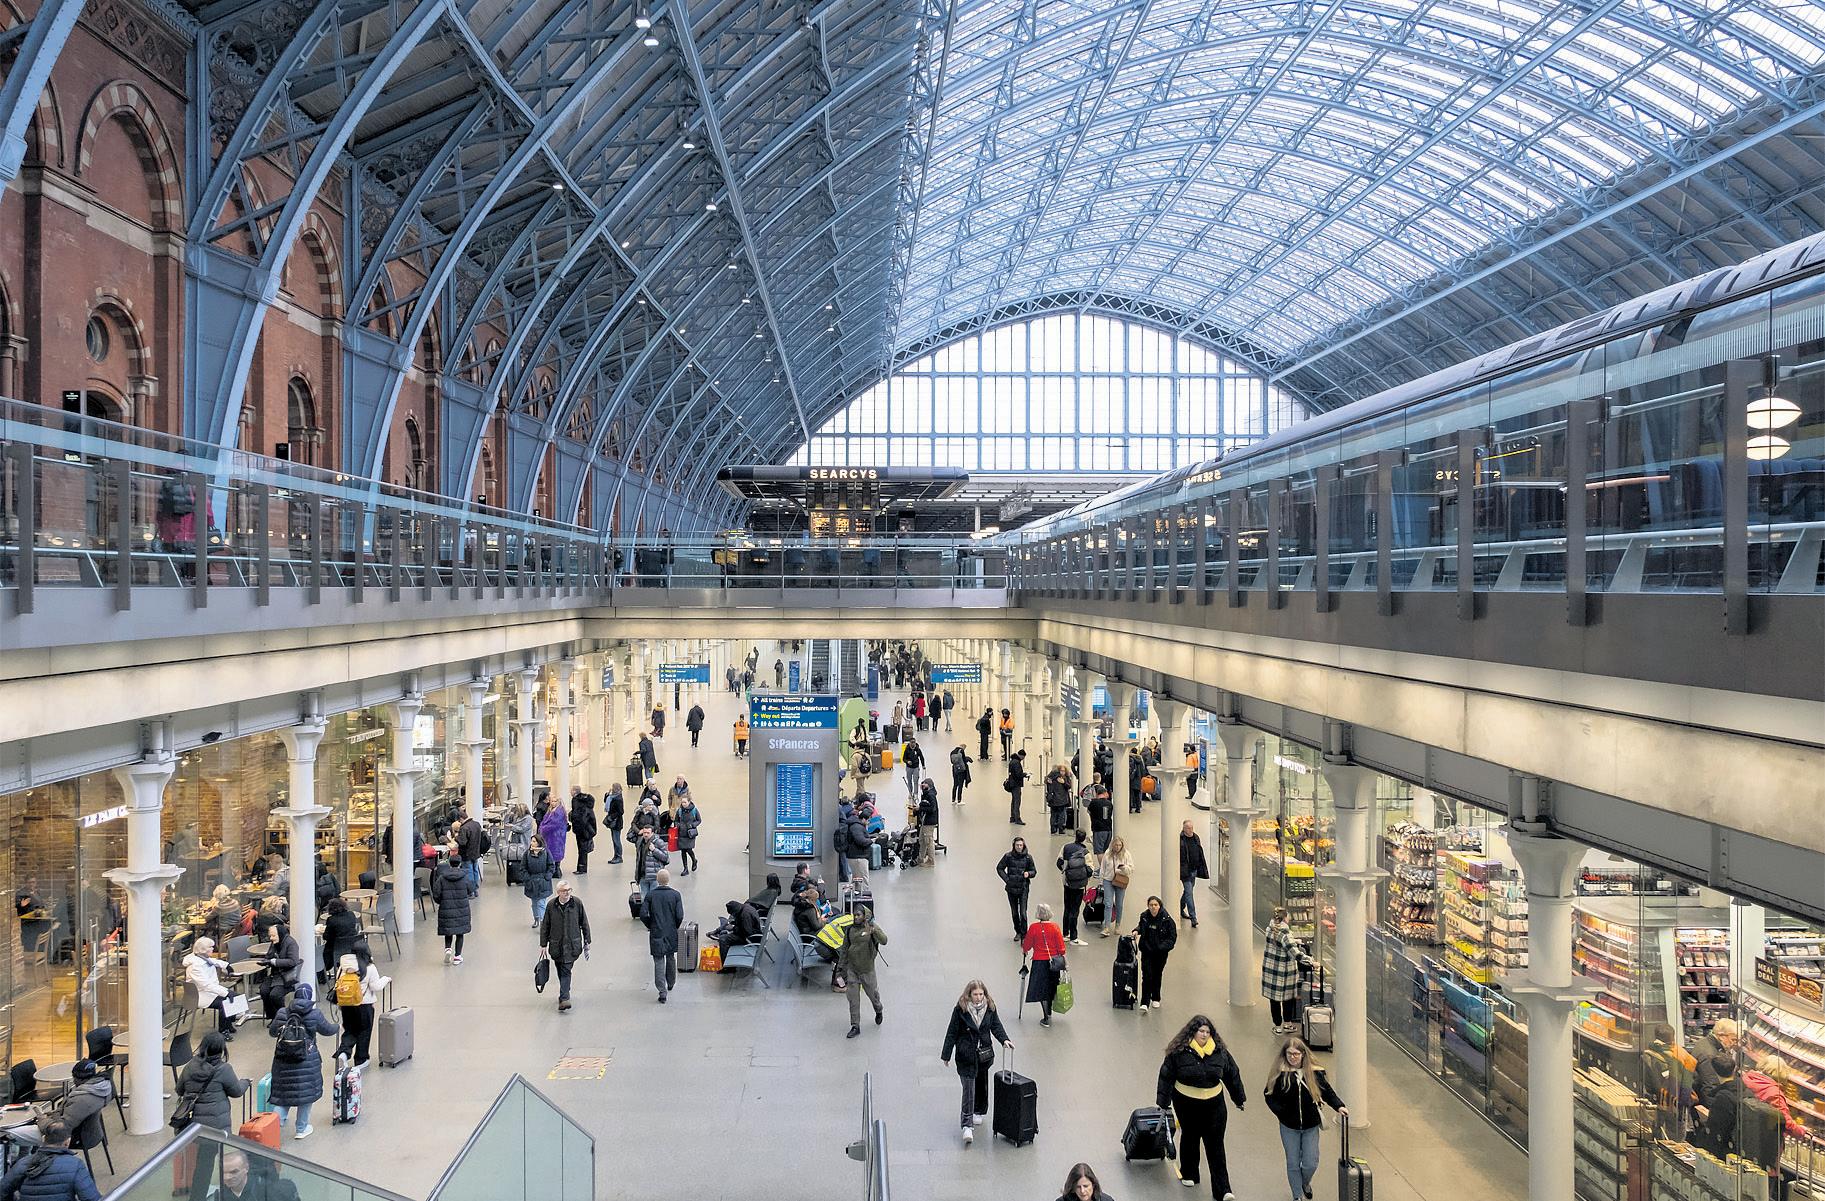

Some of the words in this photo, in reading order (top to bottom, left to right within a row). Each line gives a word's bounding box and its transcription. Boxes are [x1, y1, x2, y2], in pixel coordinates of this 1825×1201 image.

[810, 469, 877, 479] SEARCYS
[1757, 963, 1775, 976] MEAL
[1757, 970, 1775, 984] DEAL
